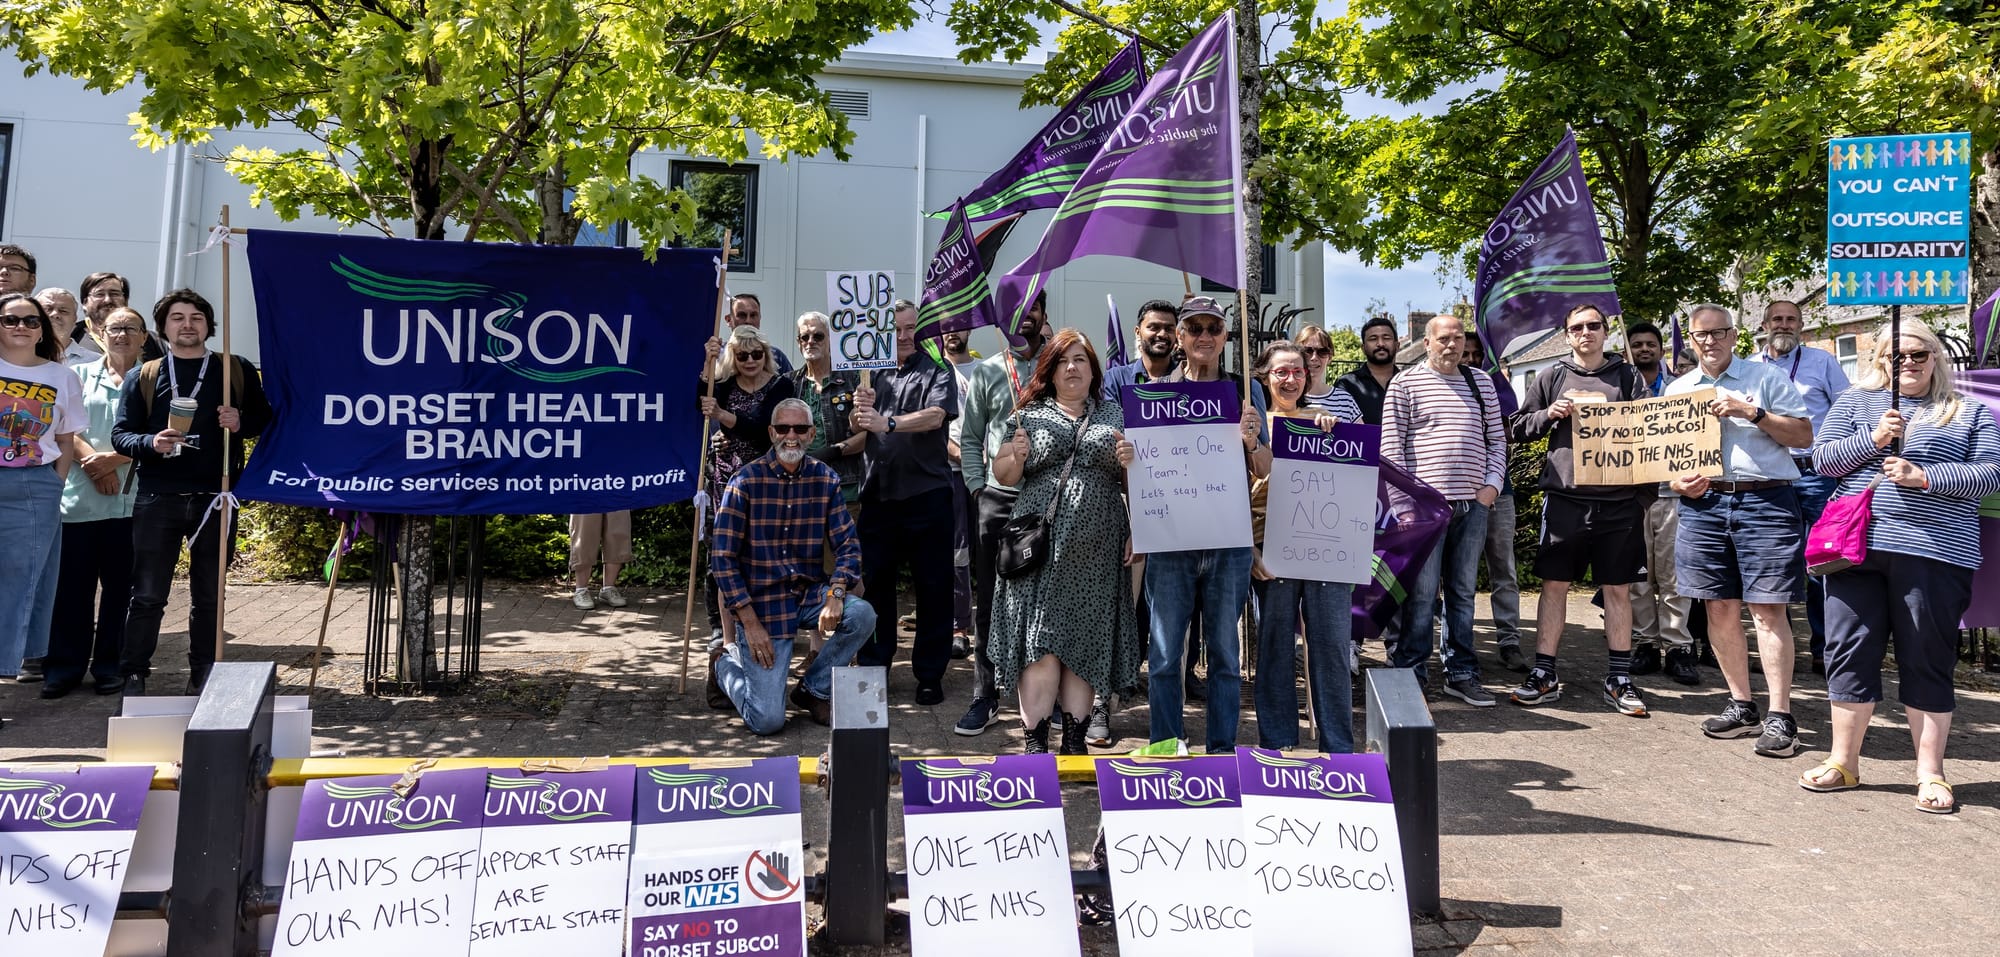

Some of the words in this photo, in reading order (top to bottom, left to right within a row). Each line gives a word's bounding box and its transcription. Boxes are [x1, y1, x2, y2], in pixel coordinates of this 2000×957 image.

[1838, 179, 1882, 194] YOU
[1893, 174, 1958, 193] CAN'T
[1832, 211, 1963, 227] OUTSOURCE
[1831, 242, 1965, 258] SOLIDARITY
[362, 307, 633, 366] UNISON
[841, 331, 892, 360] CON
[323, 392, 495, 426] DORSET
[507, 392, 664, 423] HEALTH
[1140, 399, 1221, 420] UNISON
[1580, 405, 1616, 419] STOP
[1621, 397, 1692, 416] PRIVATISATION
[1644, 413, 1660, 423] OF
[1663, 410, 1685, 420] THE
[405, 429, 582, 460] BRANCH
[1579, 426, 1611, 439] SAY
[1612, 427, 1630, 439] NO
[1632, 426, 1644, 437] TO
[1134, 439, 1160, 461] We
[1171, 446, 1189, 456] are
[1196, 435, 1225, 456] One
[1288, 434, 1364, 459] UNISON
[1582, 450, 1634, 468] FUND
[1638, 446, 1661, 464] THE
[1664, 443, 1694, 460] NHS
[1668, 459, 1697, 472] NOT
[268, 469, 310, 487] For
[317, 476, 394, 492] public
[401, 474, 499, 492] services
[505, 475, 543, 492] not
[549, 472, 626, 495] private
[632, 468, 686, 491] profit
[1141, 487, 1165, 499] Let's
[1173, 487, 1198, 498] stay
[1206, 483, 1228, 492] that
[1290, 470, 1336, 496] SAY
[1291, 501, 1340, 530] NO
[928, 776, 1036, 804] UNISON
[1122, 776, 1226, 800] UNISON
[1262, 767, 1366, 793] UNISON
[484, 788, 607, 817] UNISON
[657, 781, 774, 813] UNISON
[326, 794, 457, 828] UNISON
[1254, 815, 1321, 847] SAY
[1339, 822, 1378, 852] NO
[570, 844, 630, 866] STAFF
[913, 835, 977, 876] ONE
[984, 829, 1060, 863] TEAM
[1114, 833, 1191, 873] SAY
[1206, 838, 1247, 871] NO
[0, 853, 50, 886] DS
[64, 848, 130, 881] OFF
[289, 857, 398, 900] HANDS
[411, 849, 477, 882] OFF
[644, 869, 704, 888] HANDS
[708, 866, 739, 882] OFF
[494, 884, 549, 911] ARE
[644, 891, 681, 908] OUR
[686, 883, 738, 907] NHS
[924, 893, 978, 926] ONE
[991, 890, 1046, 919] NHS
[8, 903, 90, 935] NHS!
[287, 909, 361, 946] OUR
[374, 894, 450, 930] NHS!
[563, 909, 622, 929] STAFF
[643, 924, 680, 942] SAY
[683, 921, 710, 938] NO
[714, 918, 738, 935] TO
[1118, 900, 1158, 939] TO
[643, 941, 711, 957] DORSET
[715, 934, 780, 955] SUBCO!
